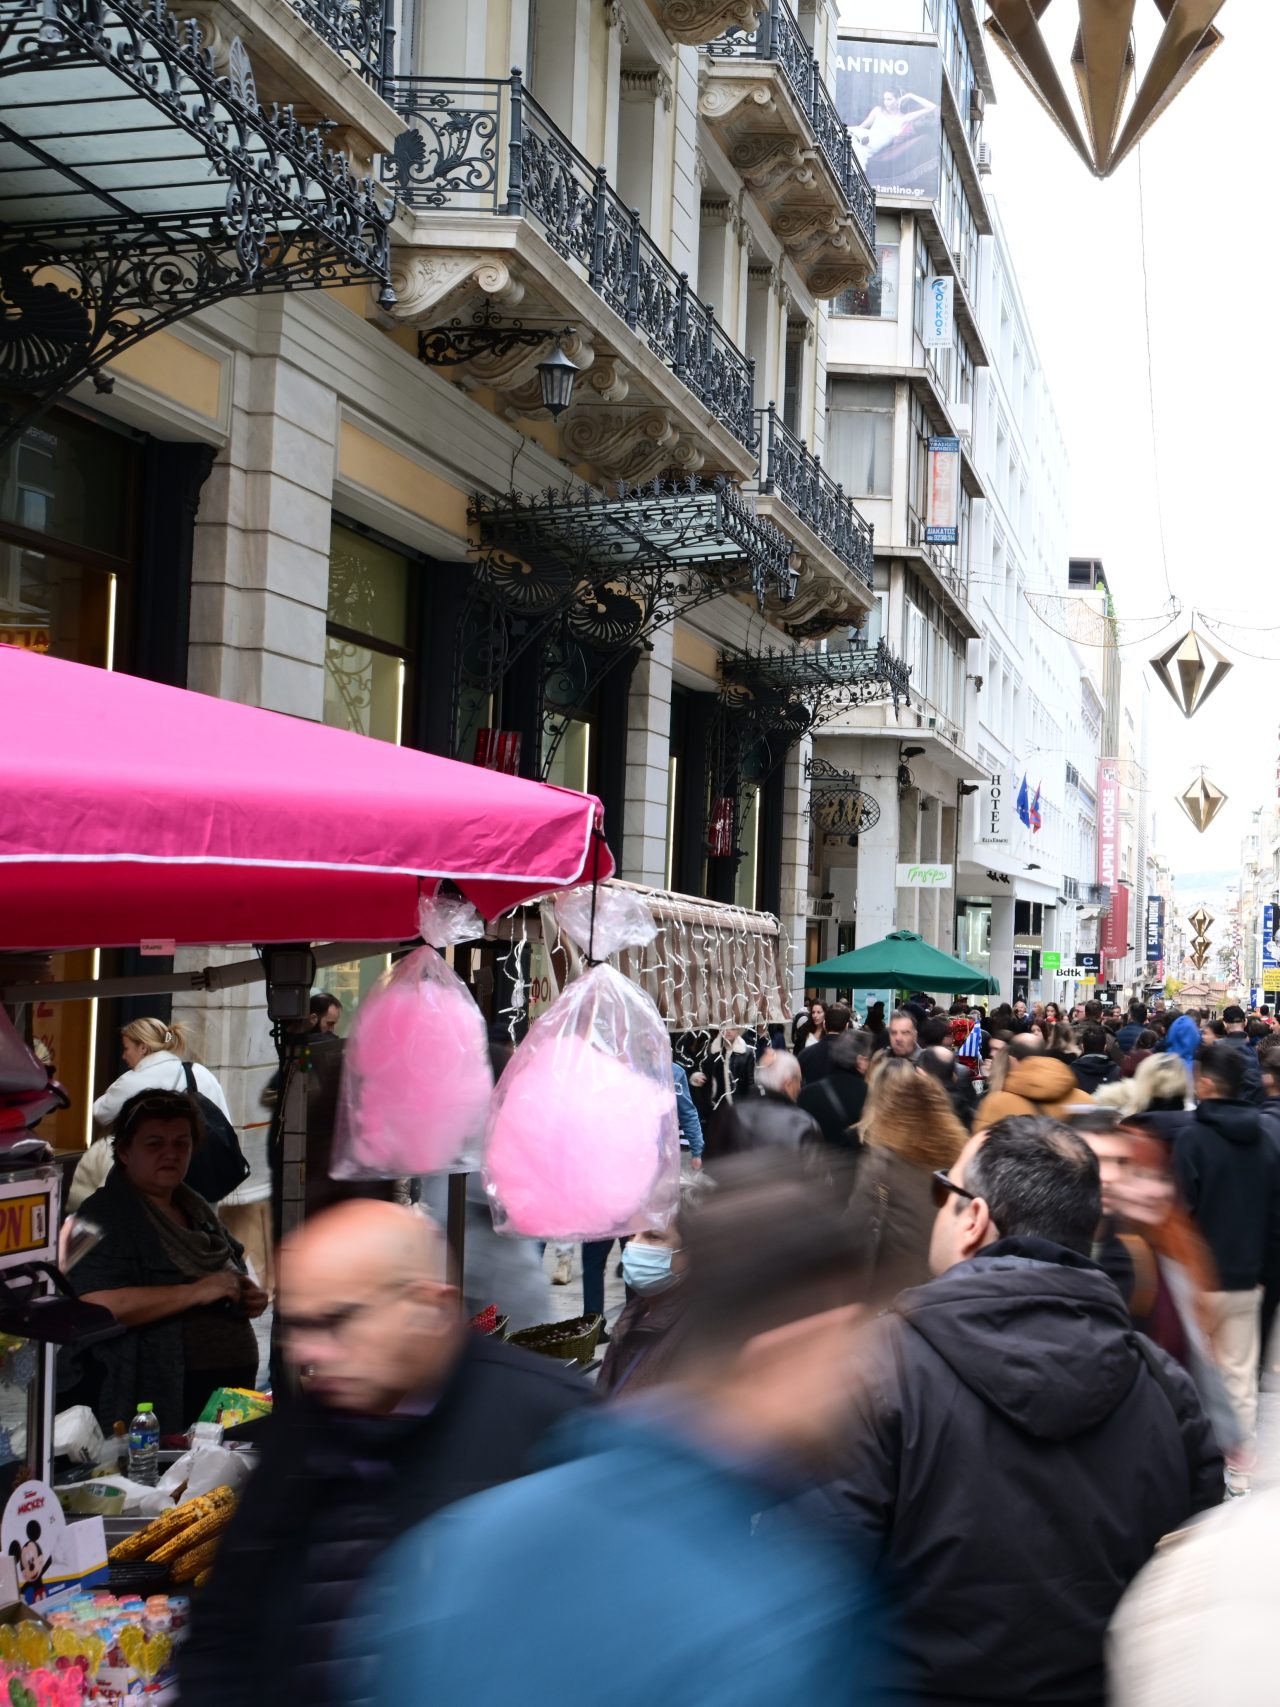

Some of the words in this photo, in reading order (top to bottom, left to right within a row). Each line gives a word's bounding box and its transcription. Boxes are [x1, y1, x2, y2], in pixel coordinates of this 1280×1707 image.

[990, 774, 1002, 834] HOTEL
[1102, 788, 1115, 838] HOUSE
[1102, 842, 1115, 887] LAPIN
[1148, 923, 1158, 945] SLAM
[1056, 967, 1082, 977] Bdtk
[17, 1497, 45, 1516] MICKEY
